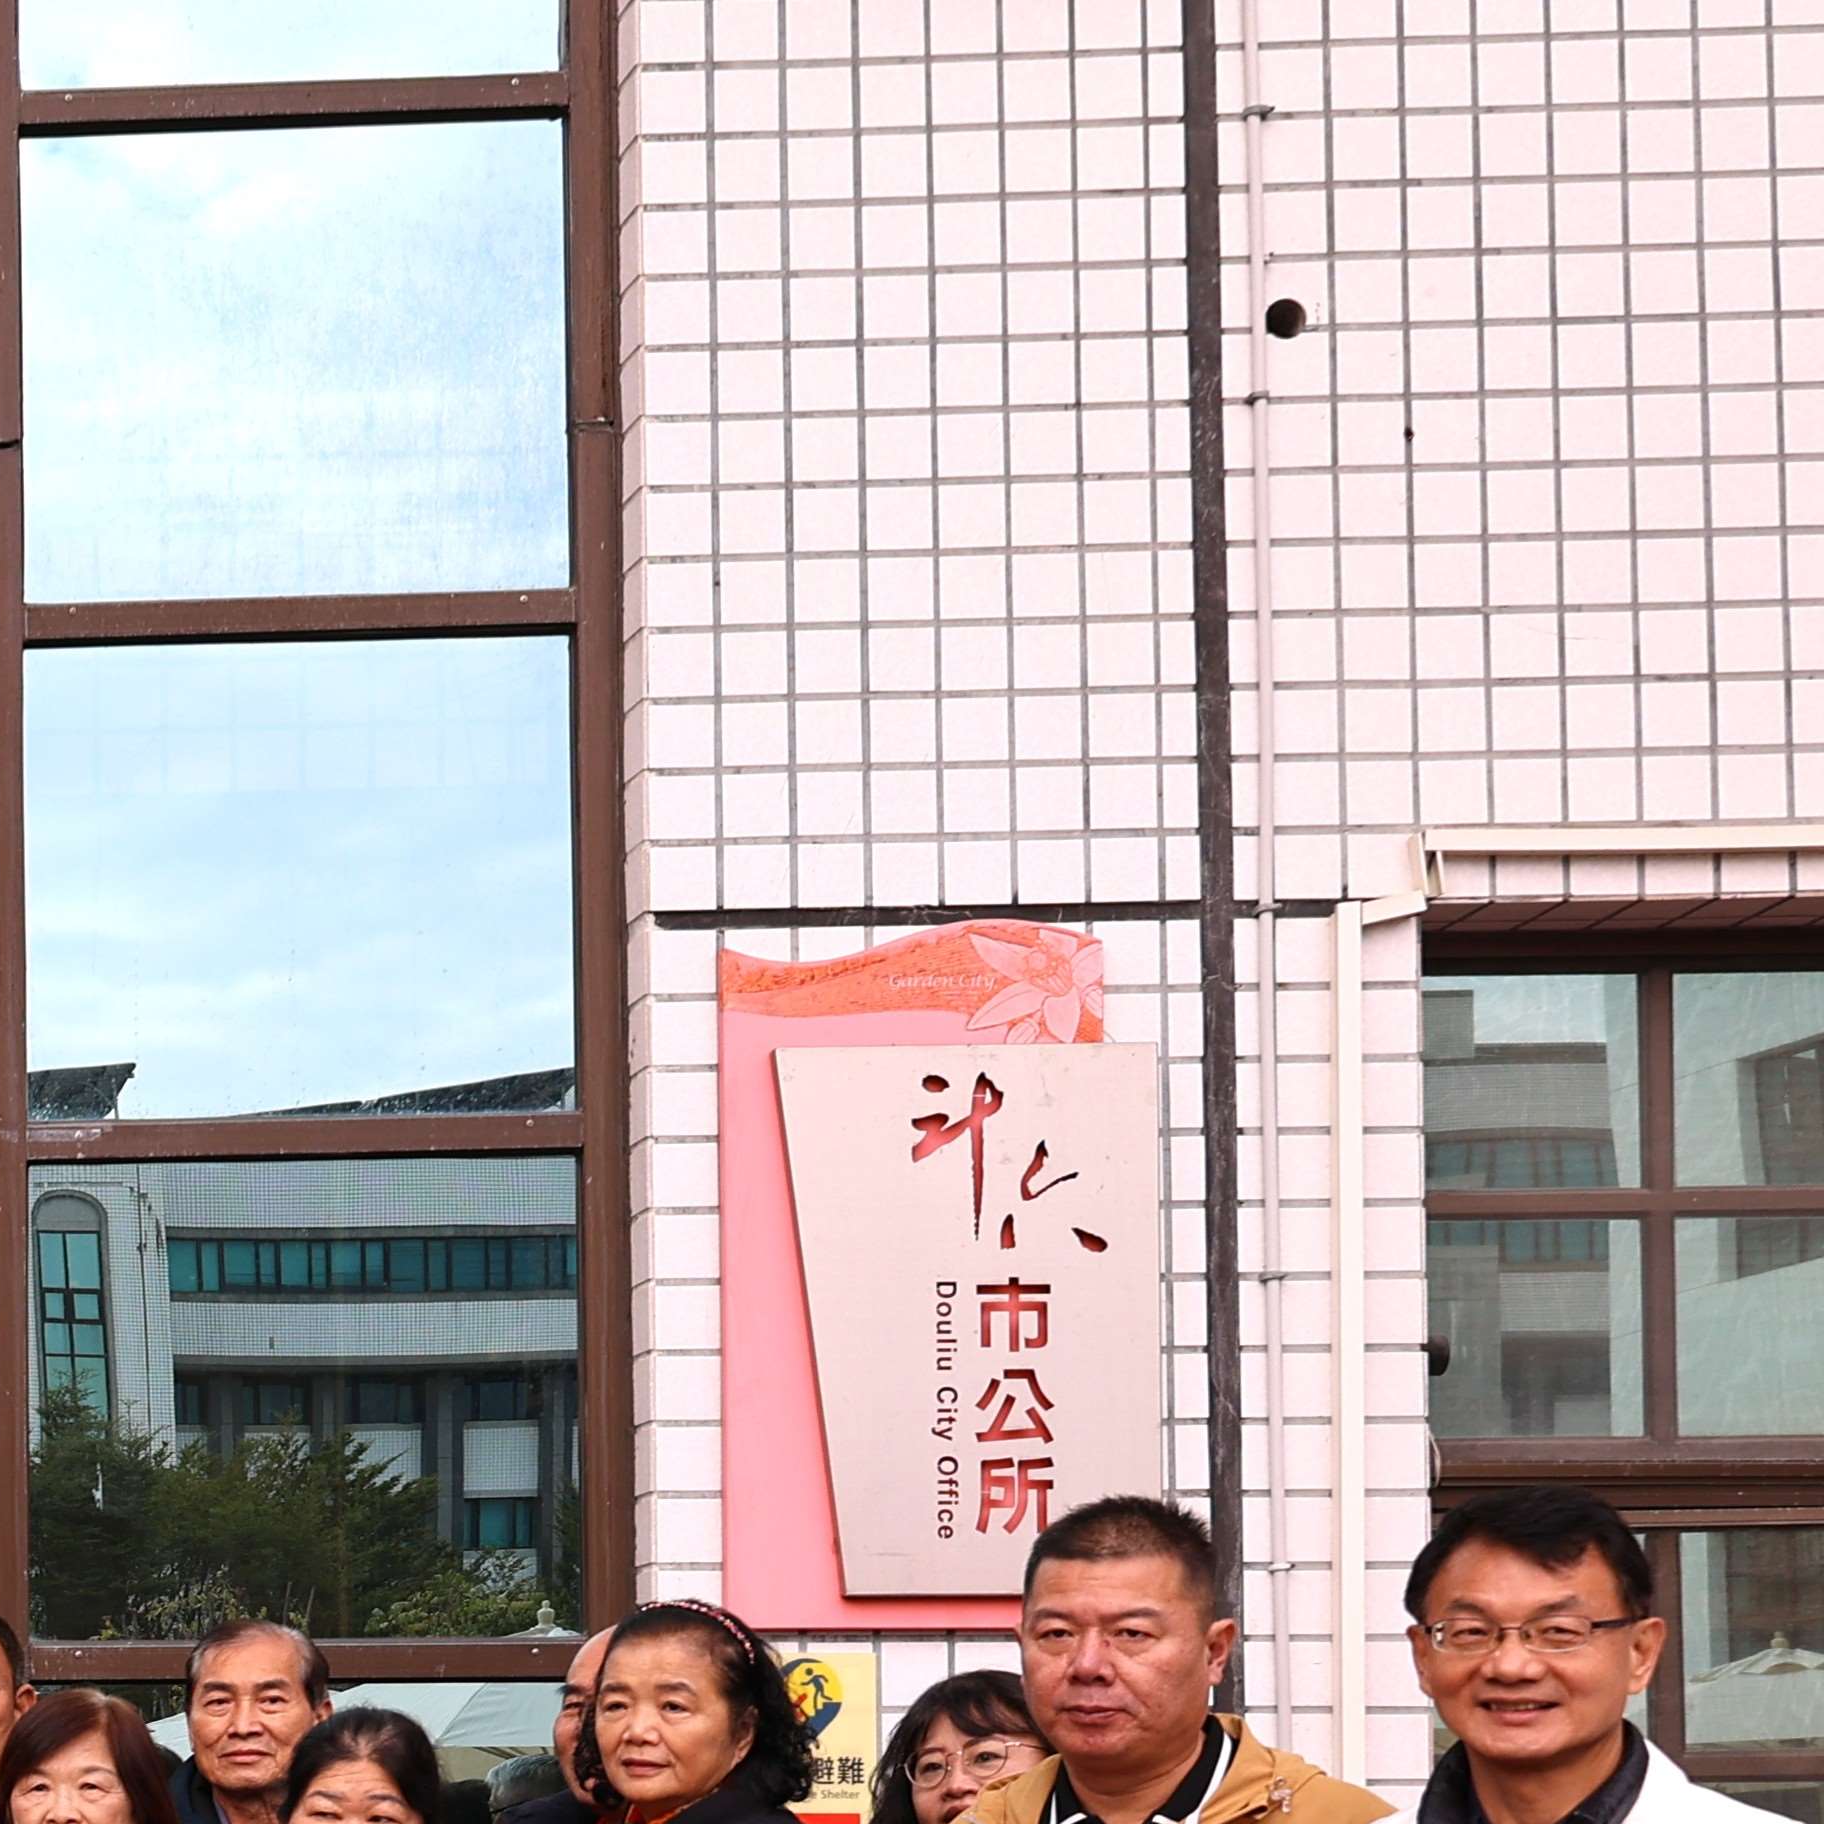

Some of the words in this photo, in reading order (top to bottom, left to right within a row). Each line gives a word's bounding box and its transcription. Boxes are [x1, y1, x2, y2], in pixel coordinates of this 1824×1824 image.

[935, 1281, 959, 1371] Douliu
[933, 1387, 959, 1441] City
[934, 1455, 960, 1539] Office
